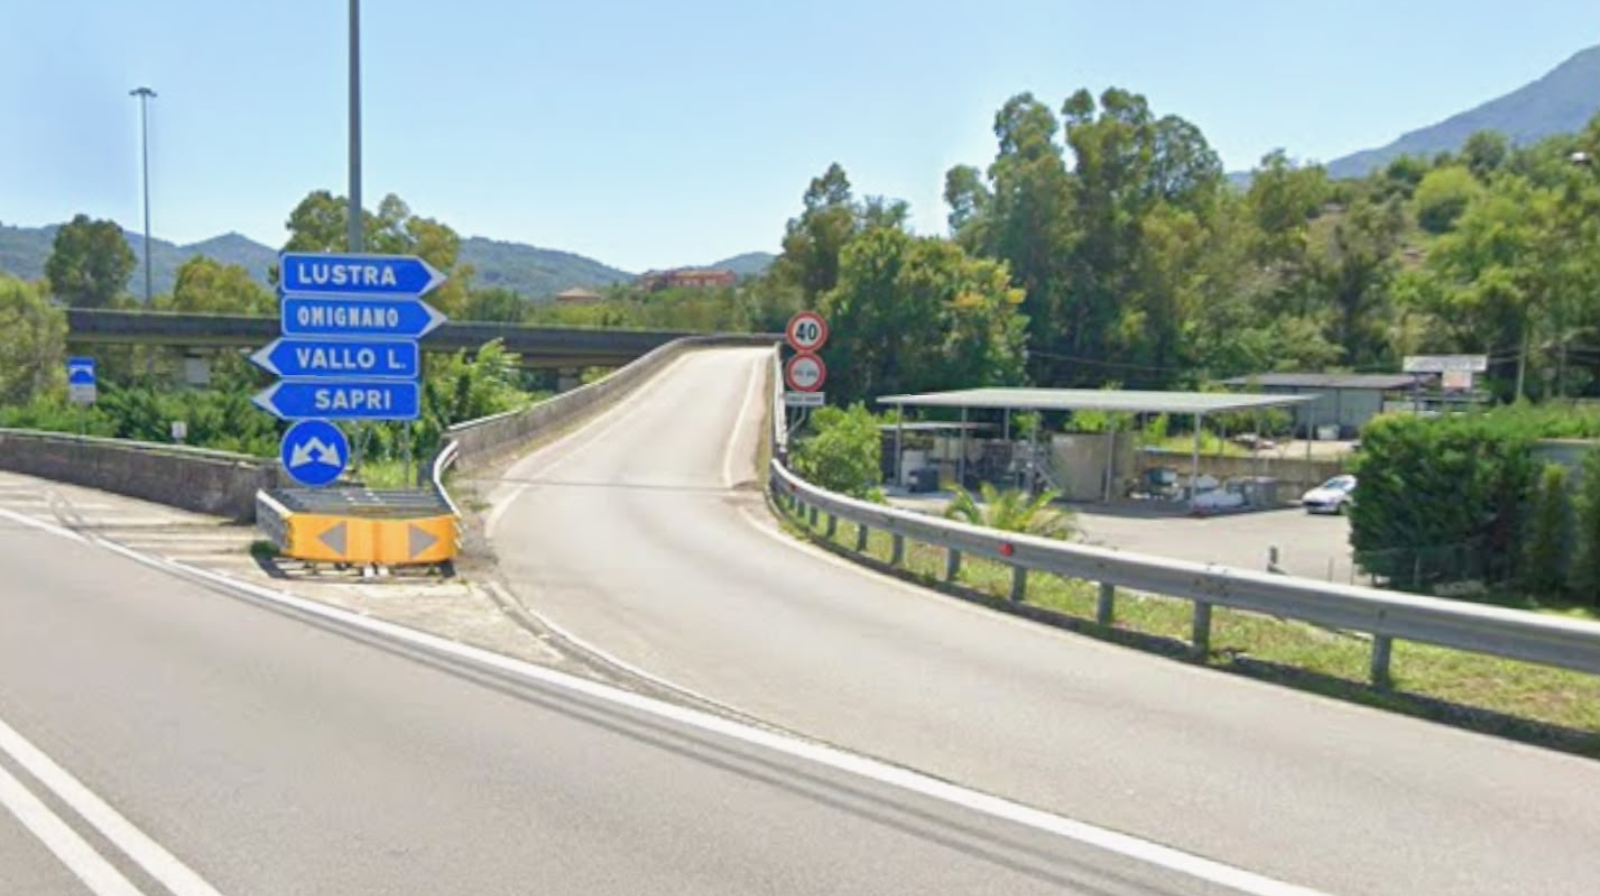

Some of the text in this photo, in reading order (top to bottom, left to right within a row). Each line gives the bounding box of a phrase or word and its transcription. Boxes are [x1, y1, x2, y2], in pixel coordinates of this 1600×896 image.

[298, 264, 396, 285] LUSTRA
[297, 306, 398, 327] OMIGNANO
[796, 323, 817, 340] 40
[296, 348, 407, 369] VALLO L.
[315, 389, 390, 410] SAPRI
